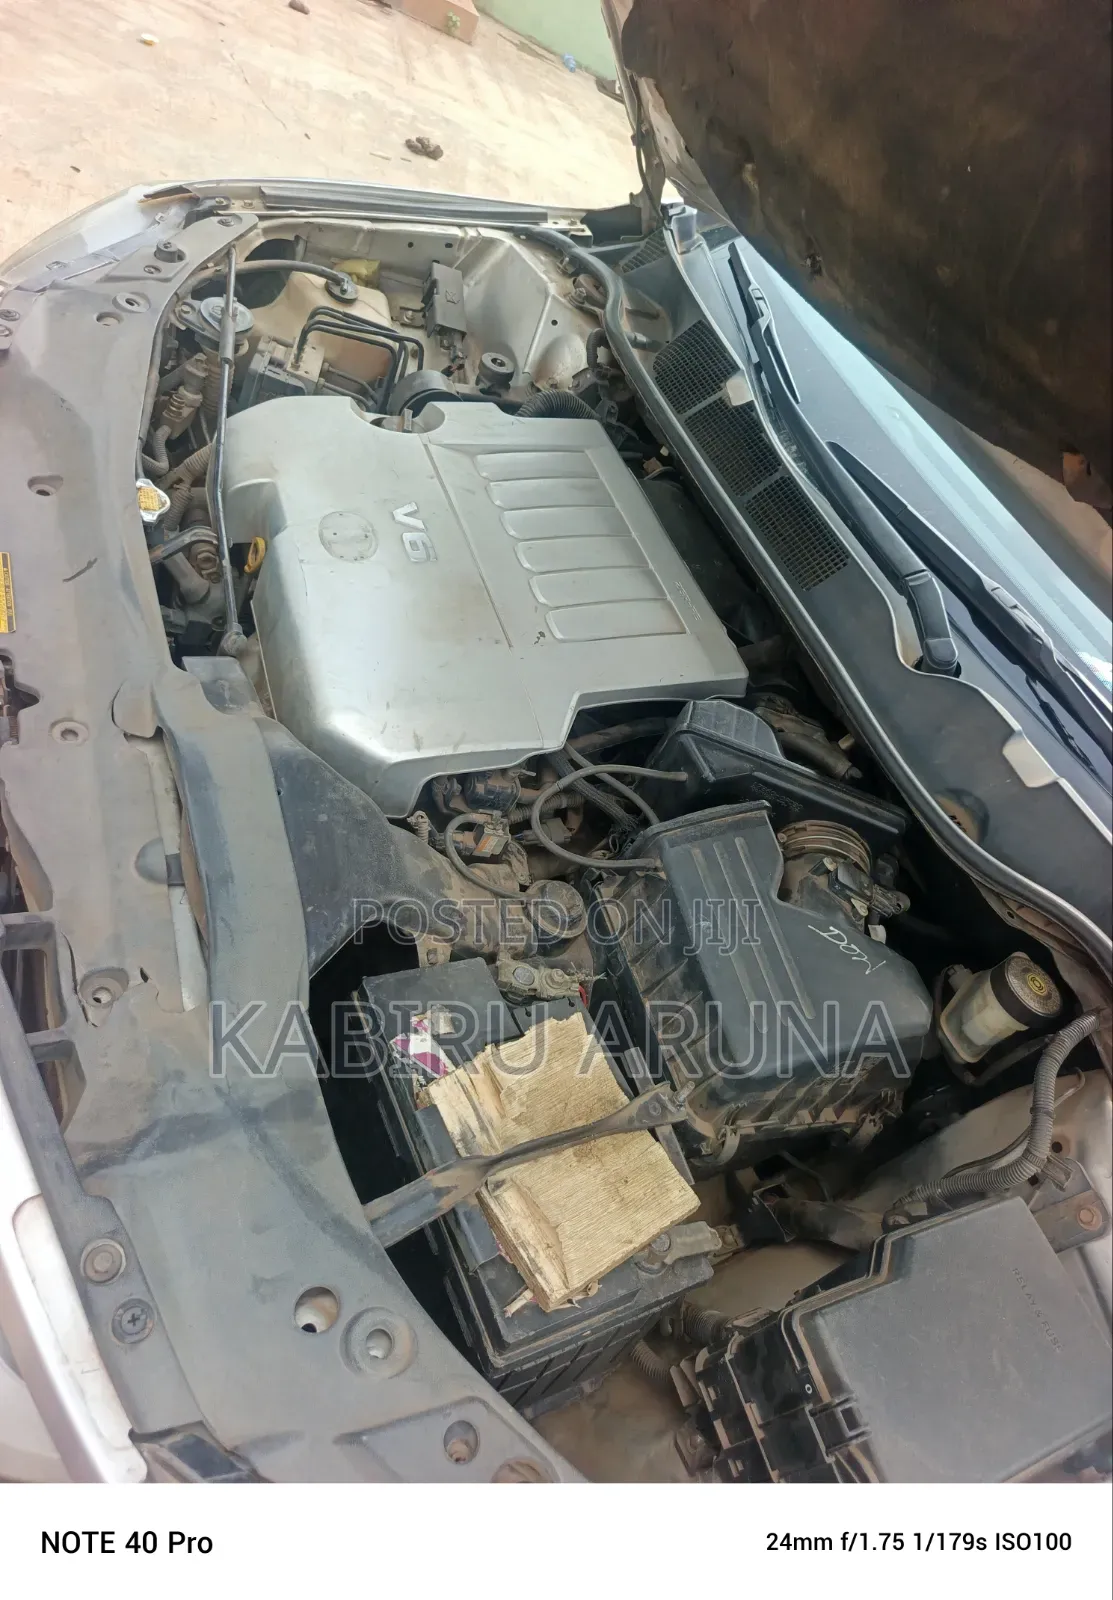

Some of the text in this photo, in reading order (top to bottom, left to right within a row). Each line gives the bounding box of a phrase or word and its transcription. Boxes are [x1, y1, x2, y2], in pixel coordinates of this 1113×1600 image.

[391, 501, 438, 563] V6
[1011, 1267, 1037, 1306] RELAY
[1041, 1320, 1065, 1353] FUSE
